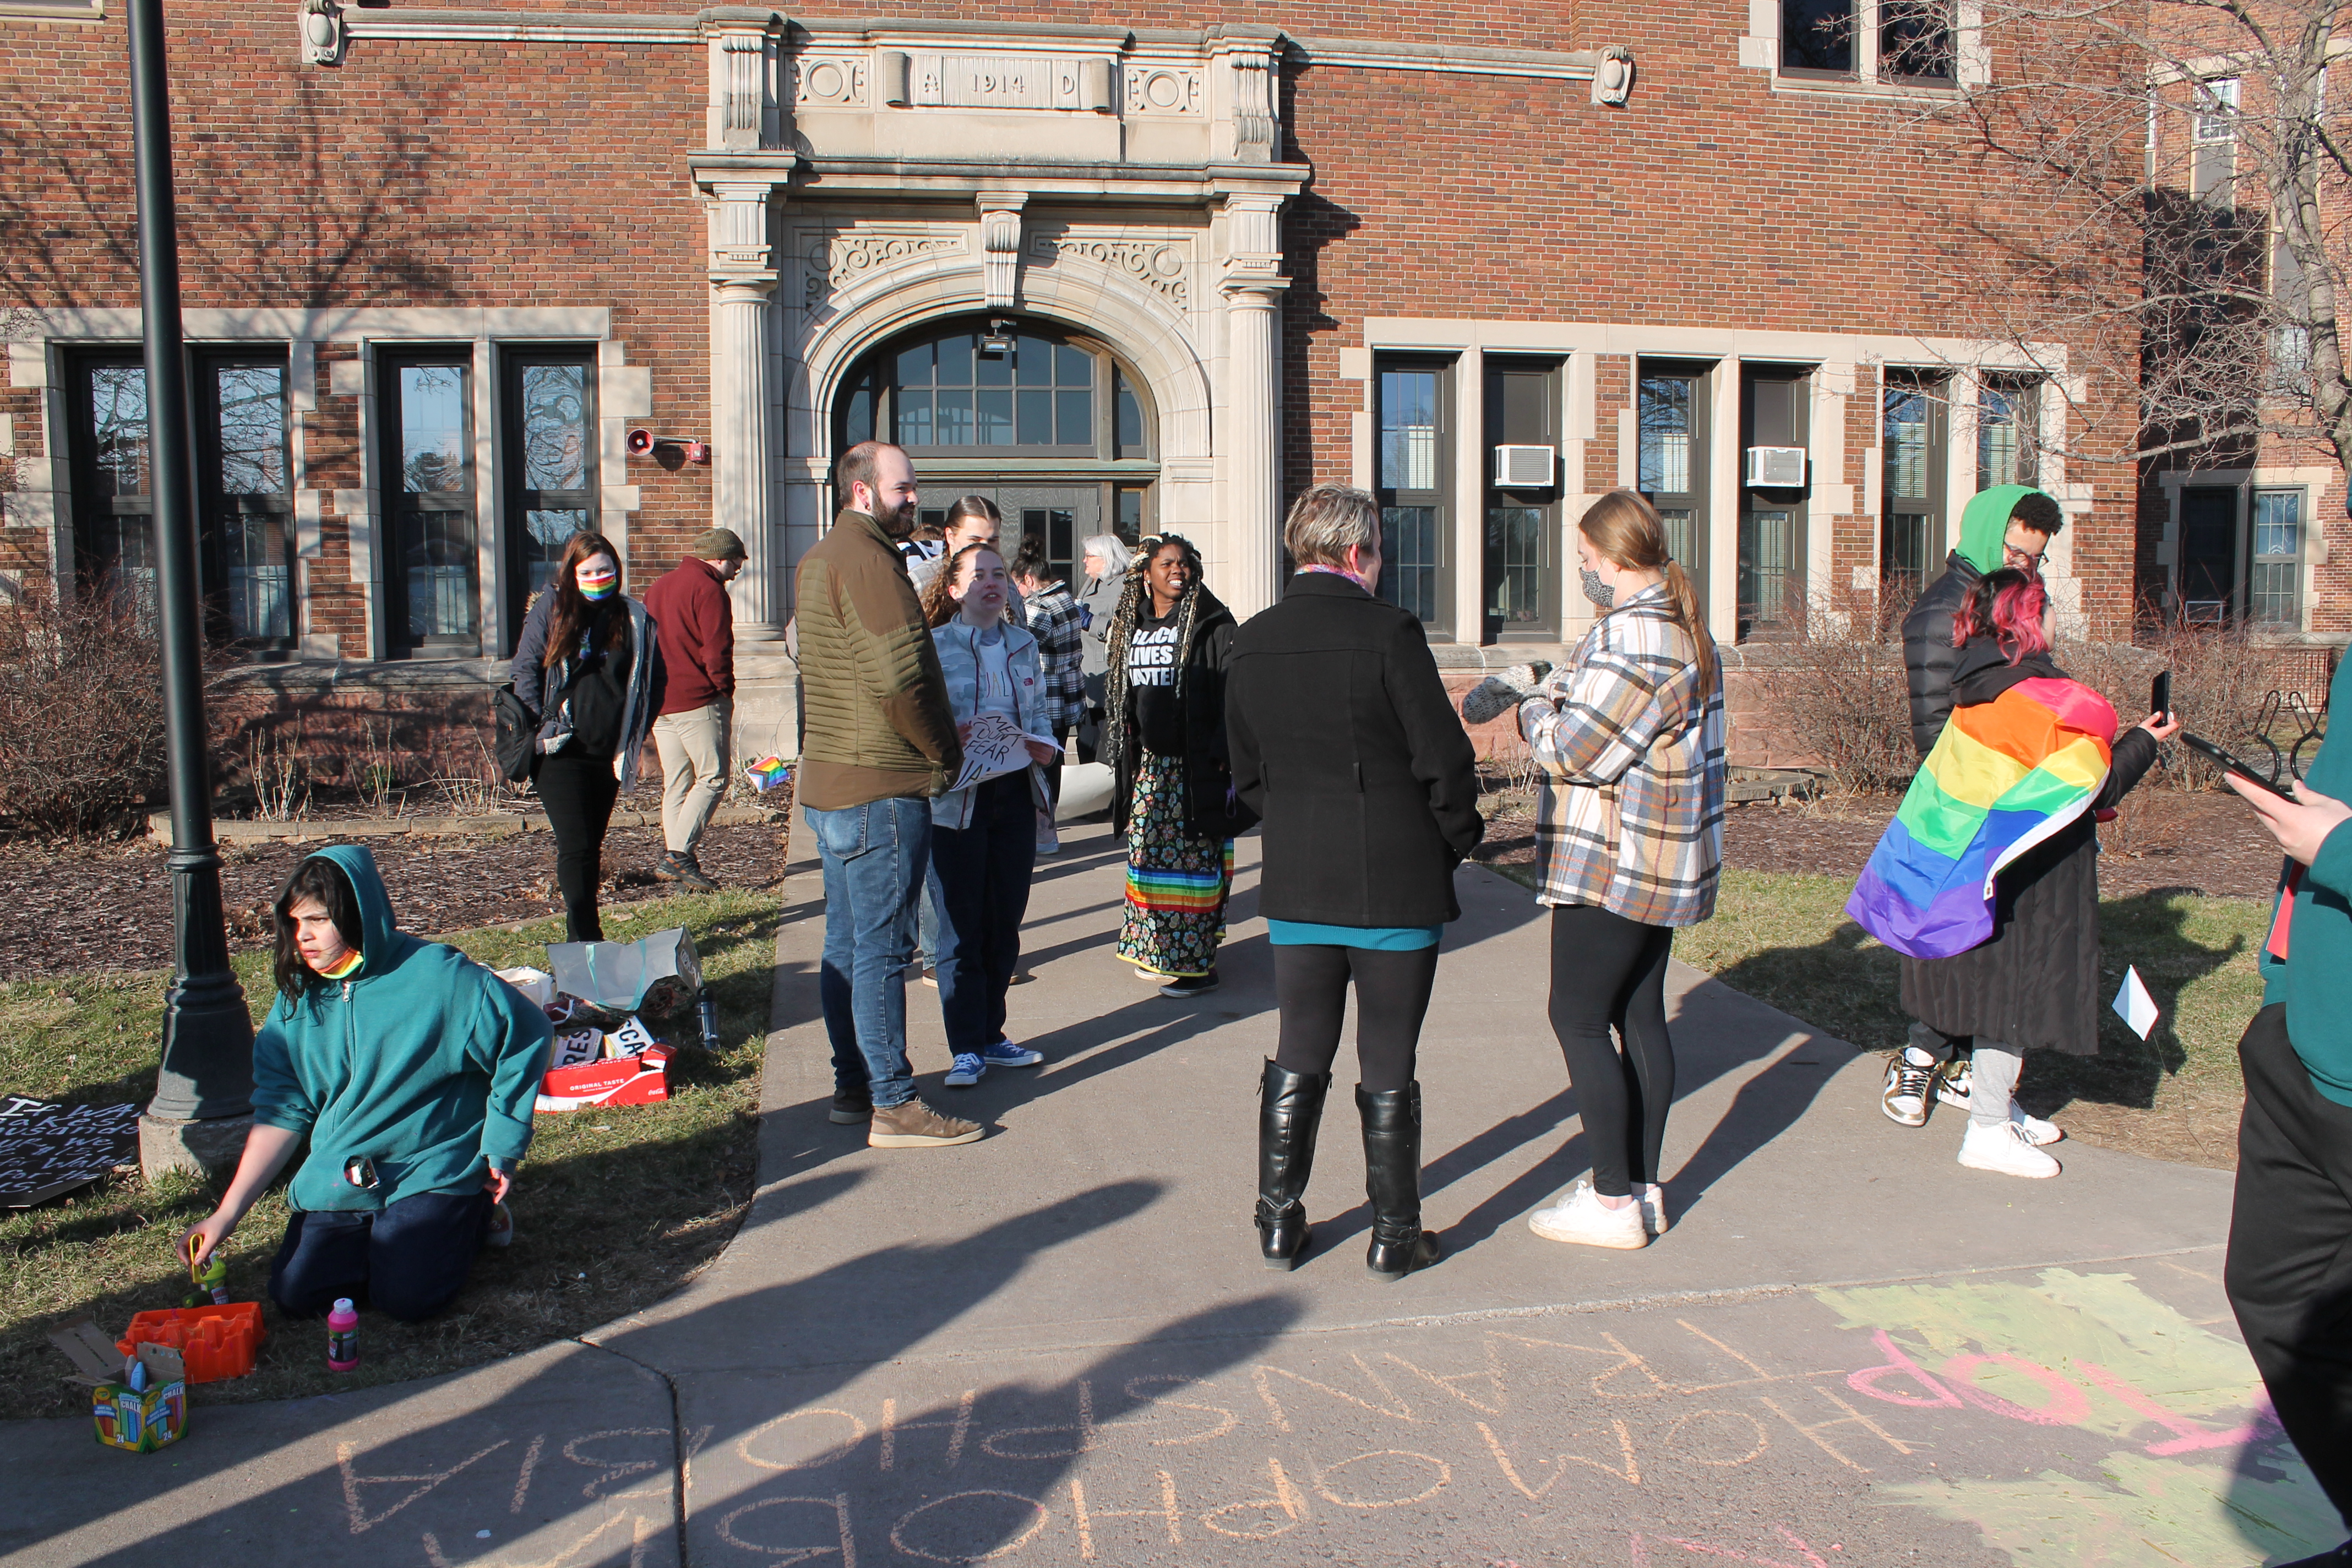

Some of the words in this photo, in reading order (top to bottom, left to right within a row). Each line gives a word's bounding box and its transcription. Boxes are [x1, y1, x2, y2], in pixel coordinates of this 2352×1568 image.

[923, 72, 939, 93] A
[971, 72, 1025, 94] 1914
[1061, 74, 1075, 95] D
[1129, 645, 1174, 666] LIVES
[964, 740, 1010, 765] FEAR
[569, 1082, 602, 1091] ORIGINAL
[603, 1078, 625, 1086] TASTE
[0, 1097, 62, 1117] If
[164, 1385, 184, 1400] CHALK
[1847, 1328, 2284, 1458] TOP
[121, 1400, 141, 1415] CHALK
[164, 1430, 172, 1441] 24
[336, 1319, 1849, 1535] TRANSPHOBIA
[117, 1434, 124, 1444] 24
